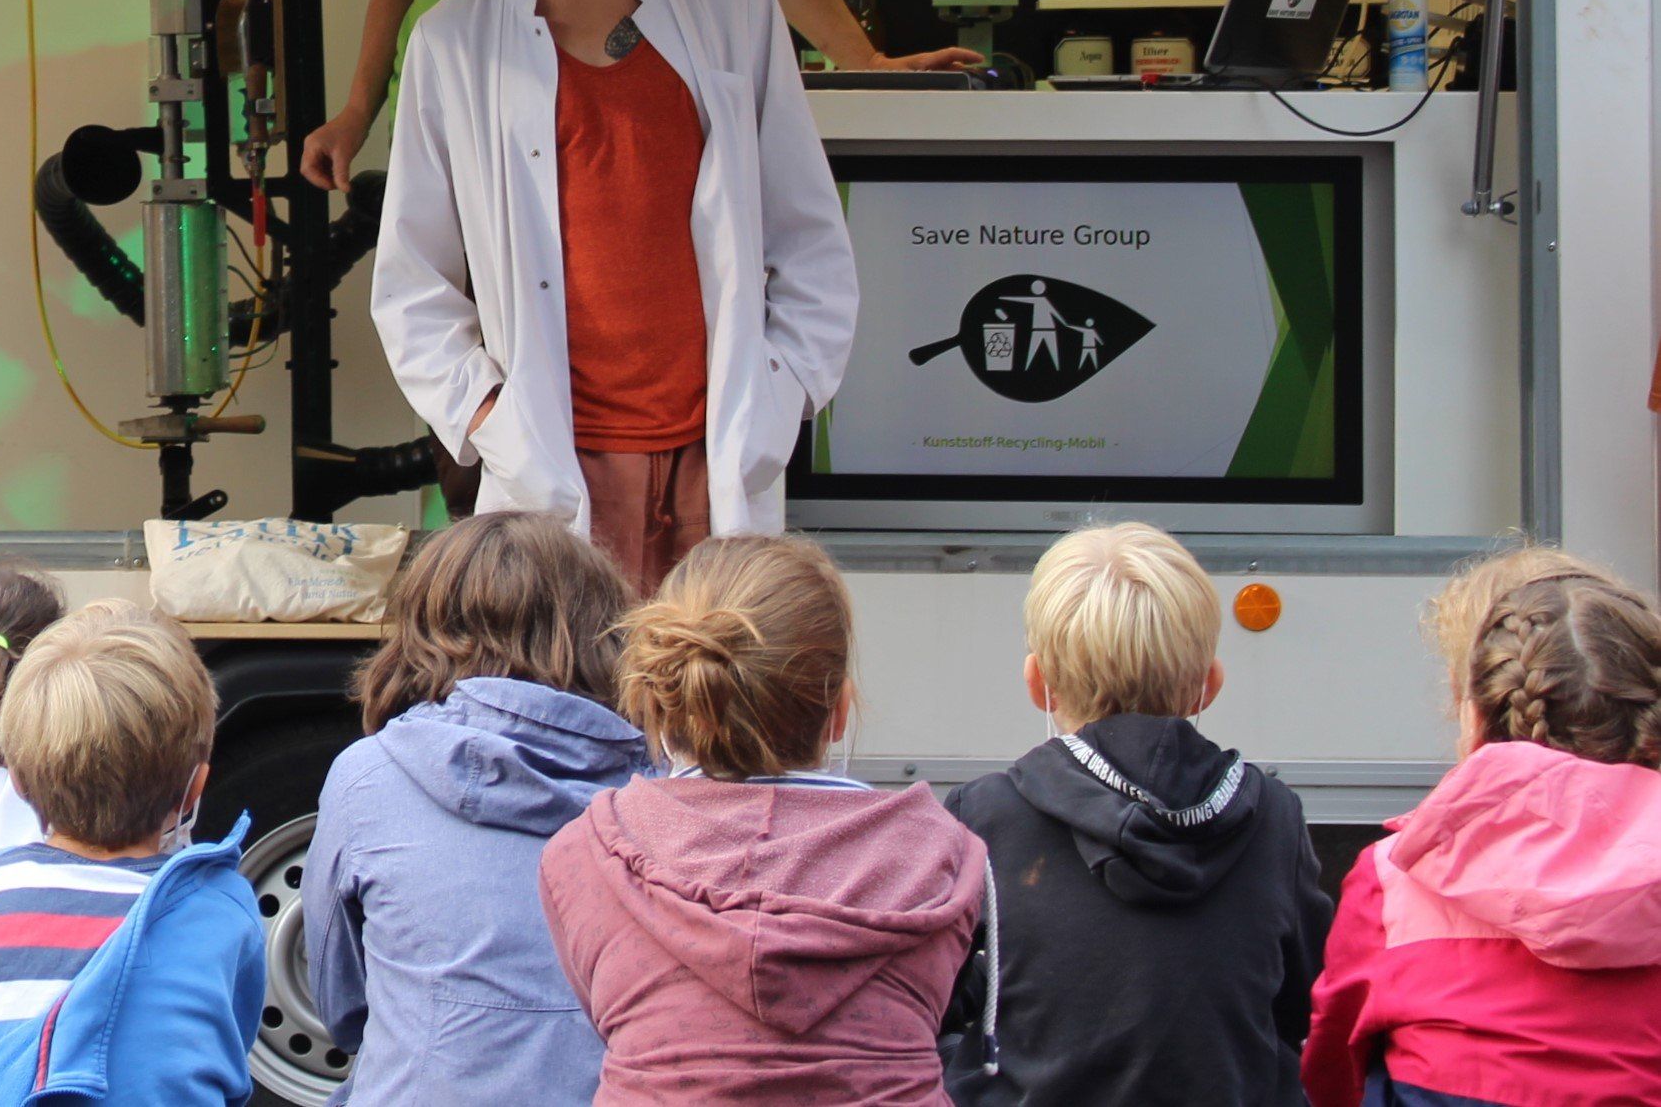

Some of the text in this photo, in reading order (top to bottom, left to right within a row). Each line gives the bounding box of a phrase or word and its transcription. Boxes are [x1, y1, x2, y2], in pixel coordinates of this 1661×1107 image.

[911, 224, 1152, 251] Save Nature Group
[1087, 753, 1122, 791] URBAN
